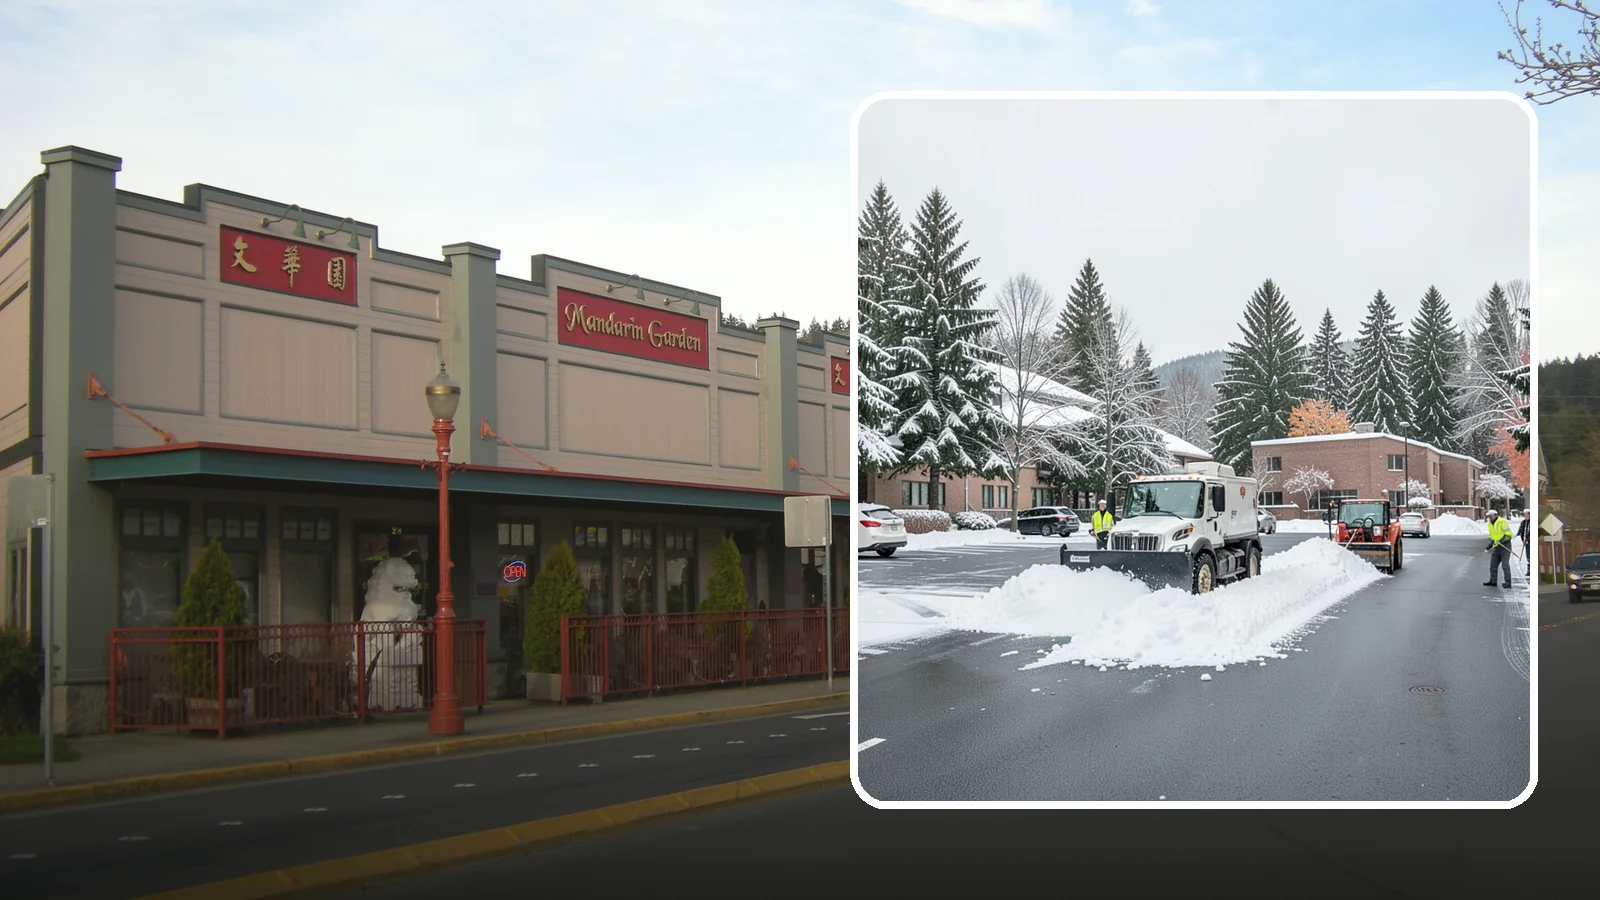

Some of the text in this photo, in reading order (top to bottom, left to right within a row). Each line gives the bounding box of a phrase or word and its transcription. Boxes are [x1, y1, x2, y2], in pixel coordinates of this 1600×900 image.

[231, 235, 346, 291] 文華園
[564, 302, 702, 352] Mandarin Garden
[503, 565, 527, 578] OPEN
